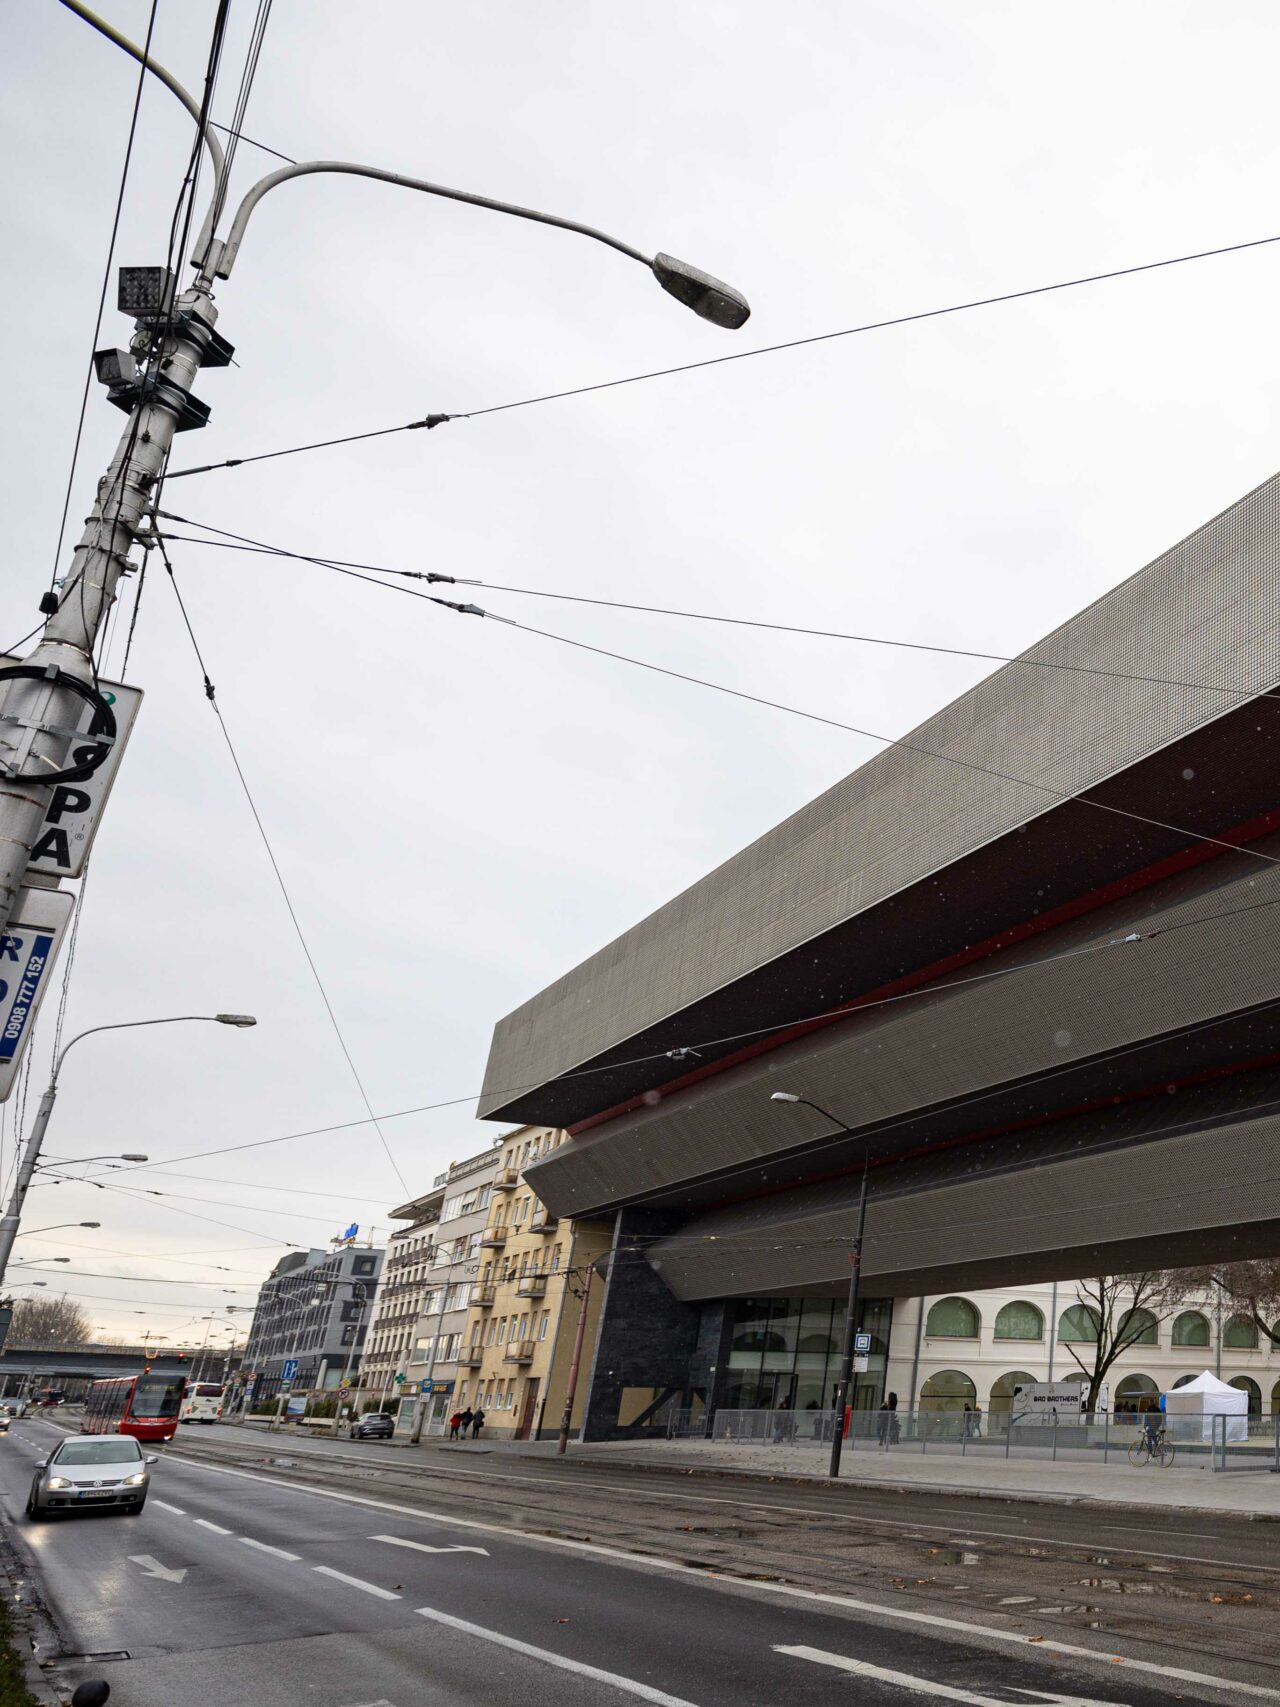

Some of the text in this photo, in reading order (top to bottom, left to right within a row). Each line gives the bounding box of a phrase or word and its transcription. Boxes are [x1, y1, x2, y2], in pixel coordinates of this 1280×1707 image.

[5, 955, 44, 1039] 0908 777 152
